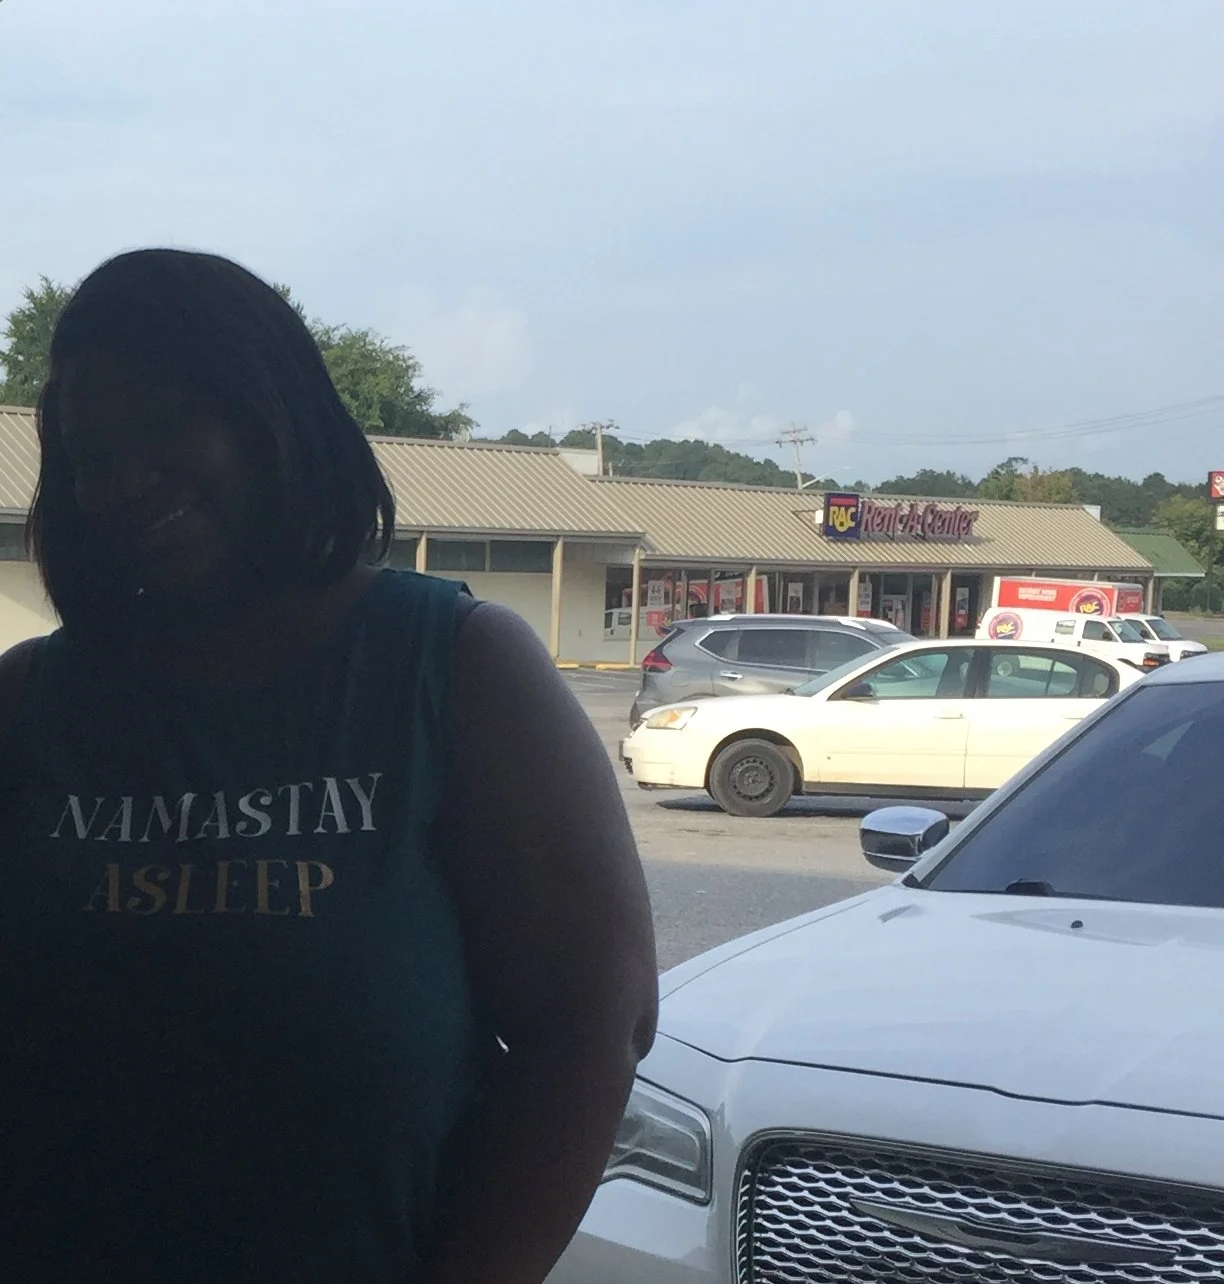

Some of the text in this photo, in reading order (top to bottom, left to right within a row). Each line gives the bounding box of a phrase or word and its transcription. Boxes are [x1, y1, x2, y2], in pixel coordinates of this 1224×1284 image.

[828, 506, 857, 533] RAC
[49, 772, 384, 843] NAMASTAY
[83, 860, 336, 918] ASLEEP
